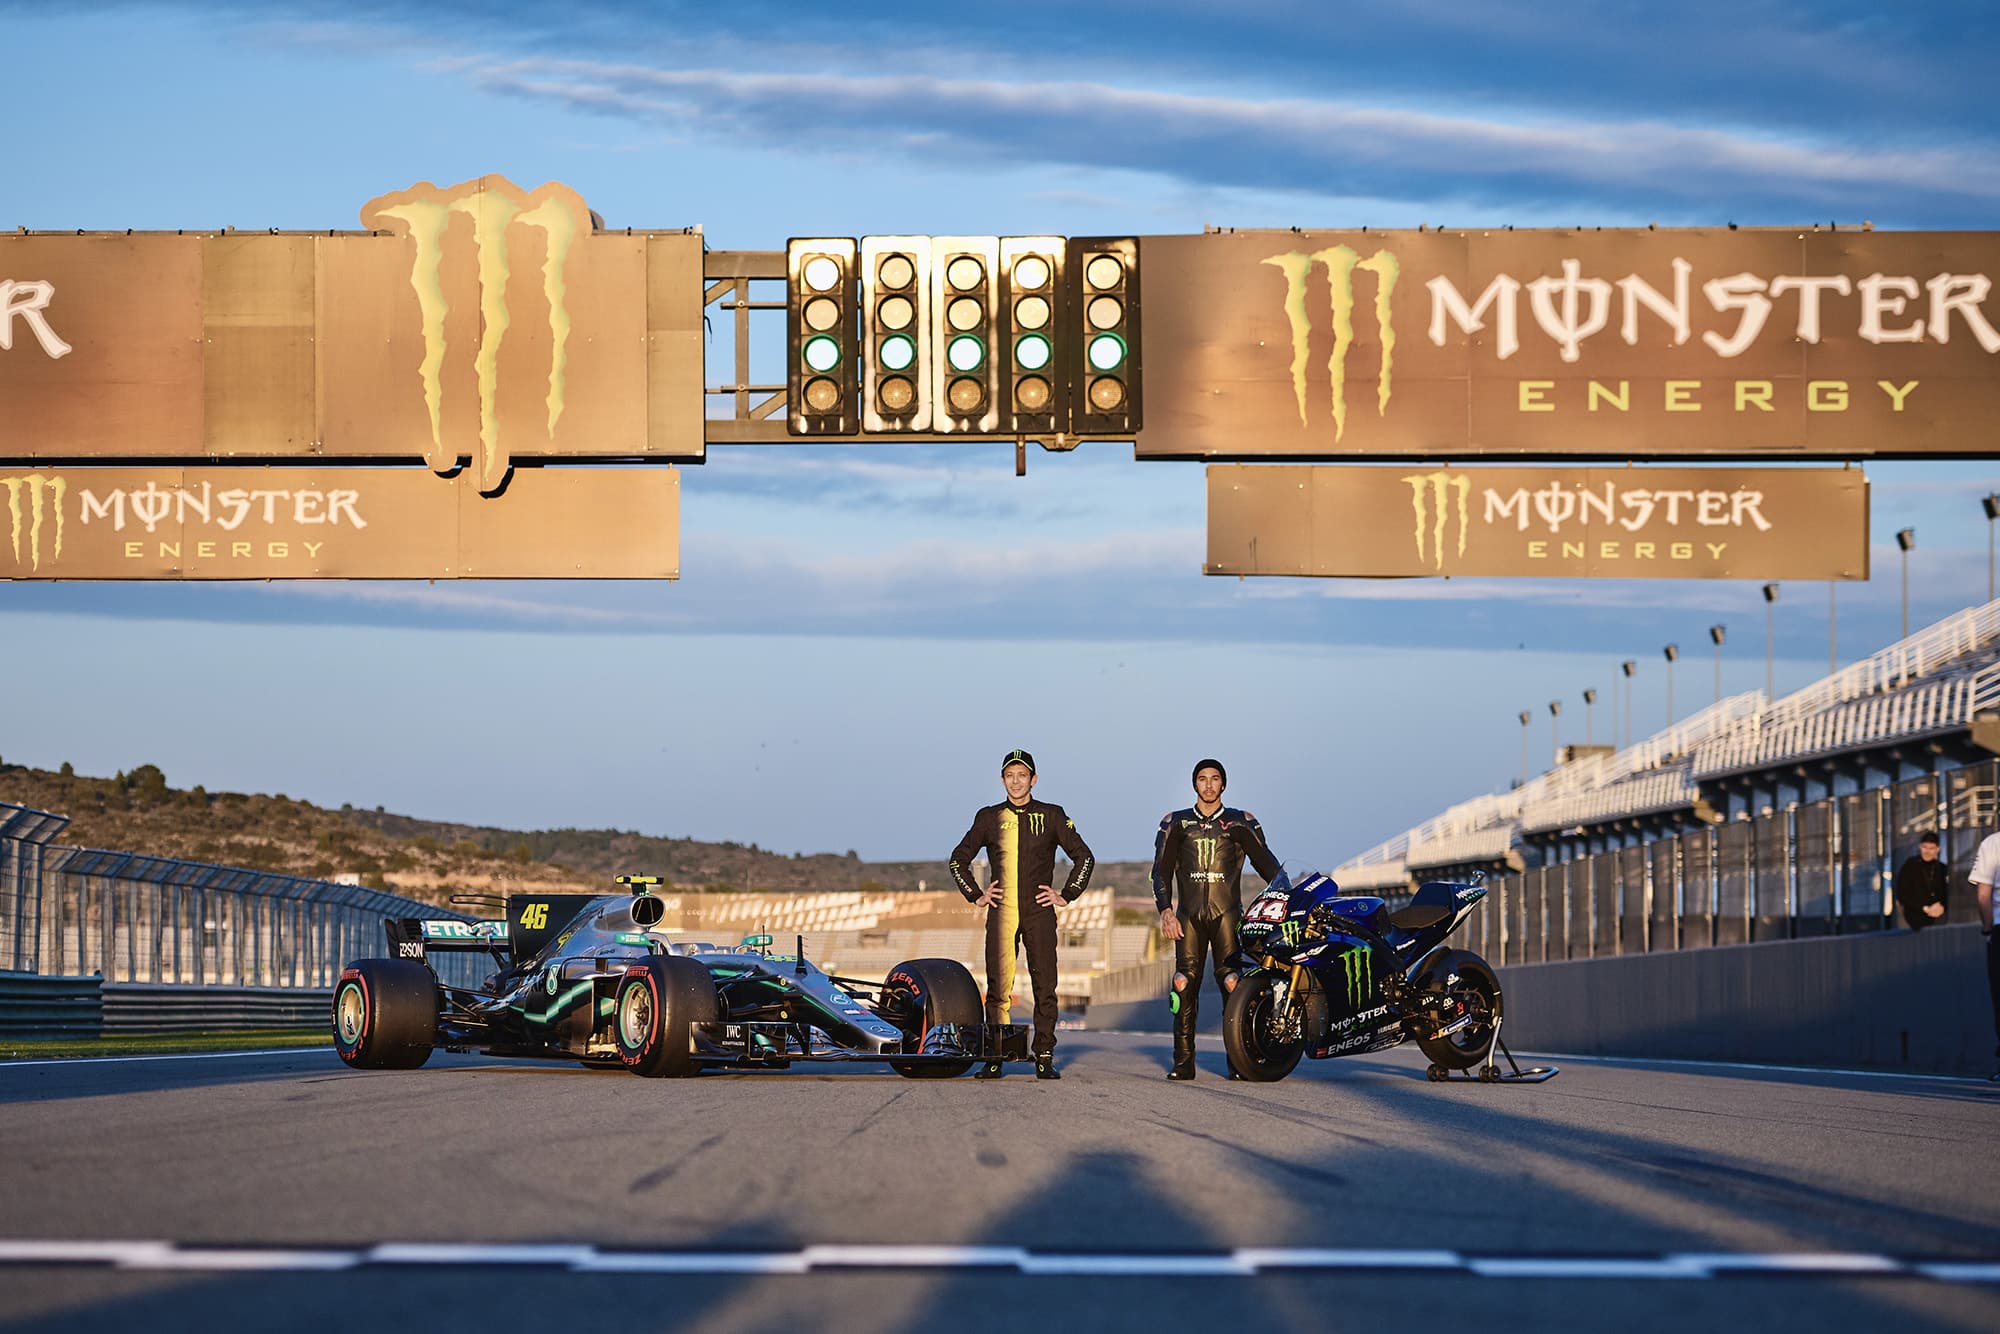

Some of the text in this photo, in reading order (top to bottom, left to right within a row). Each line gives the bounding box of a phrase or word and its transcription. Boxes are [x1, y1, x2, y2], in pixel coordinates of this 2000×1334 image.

[1425, 257, 2000, 362] MONSTER
[1518, 380, 1920, 411] ENERGY
[78, 480, 367, 533] MONSTER
[1482, 480, 1772, 533] MONSTER
[124, 542, 324, 558] ENERGY
[1527, 541, 1728, 559] ENERGY
[520, 903, 549, 929] 46
[1246, 900, 1286, 921] 44
[399, 942, 423, 958] EPSON
[891, 971, 921, 996] ZERO
[726, 1025, 741, 1039] IWC
[1328, 1032, 1371, 1055] ENEOS
